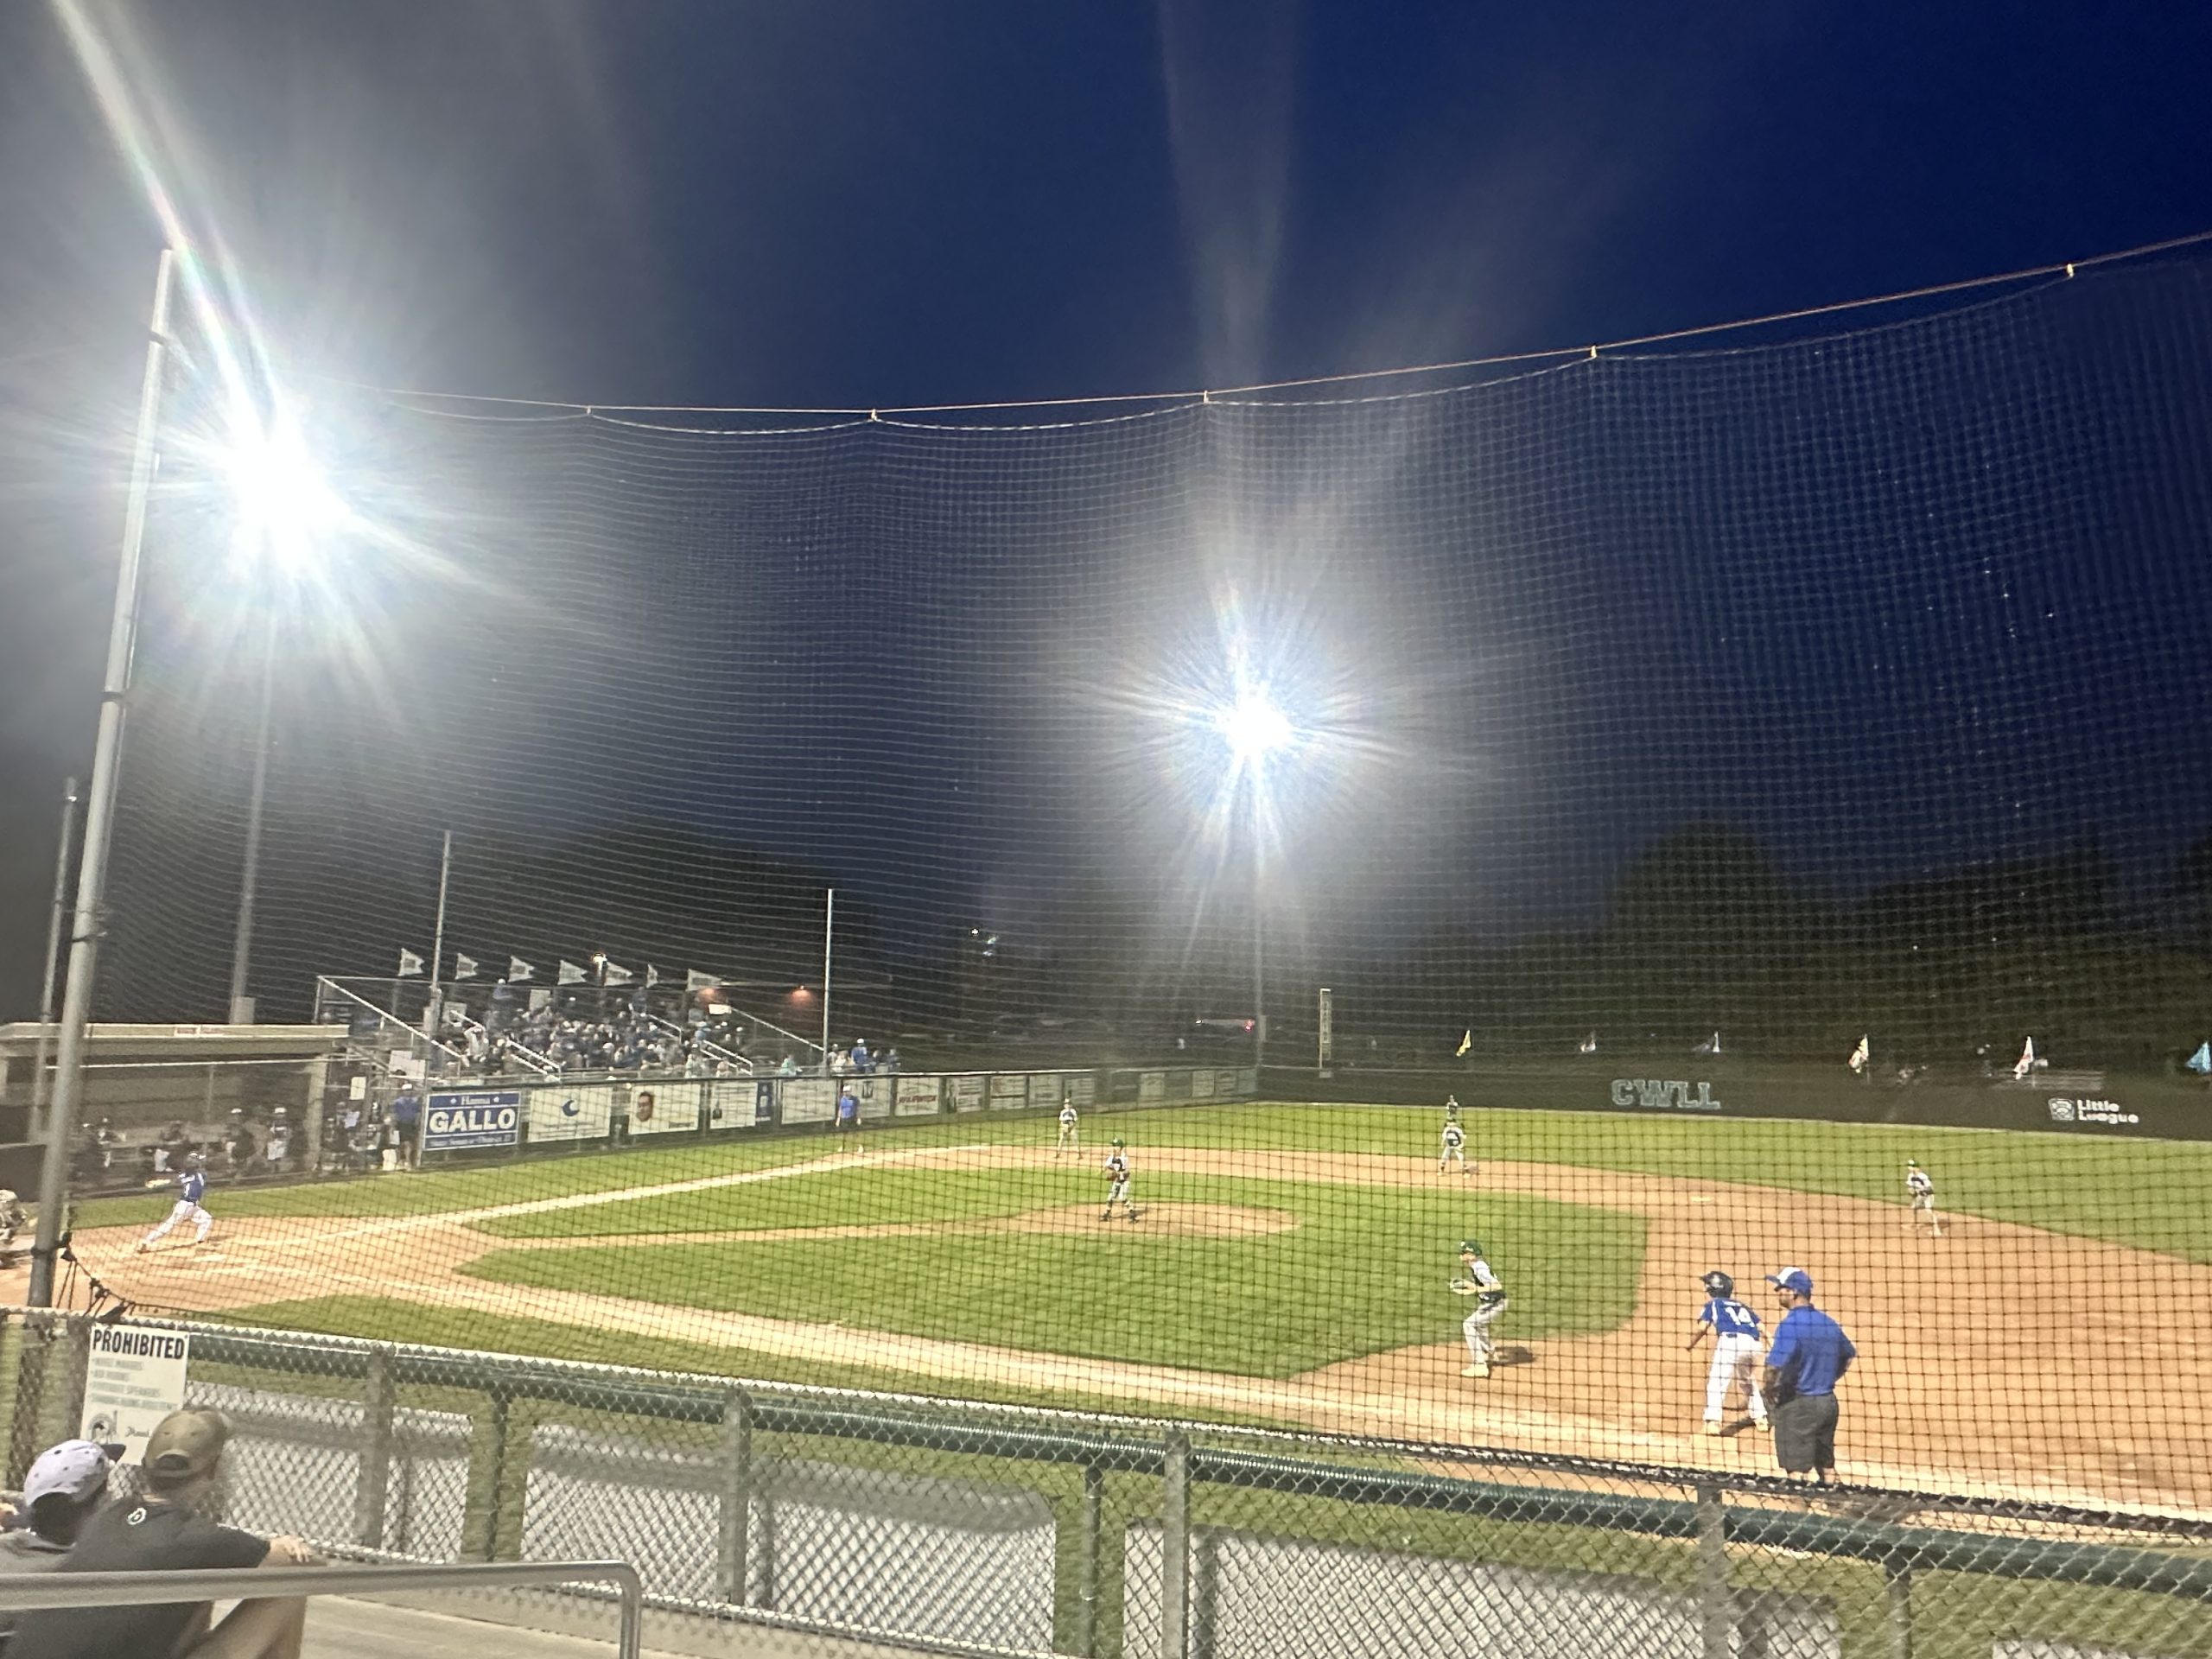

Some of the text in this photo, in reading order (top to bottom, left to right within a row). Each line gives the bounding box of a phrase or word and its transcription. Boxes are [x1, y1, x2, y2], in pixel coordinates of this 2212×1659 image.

[1611, 1078, 1721, 1110] CWLL
[2076, 1099, 2120, 1112] Little
[429, 1108, 516, 1134] GALLO
[92, 1329, 185, 1360] PROHIBITED
